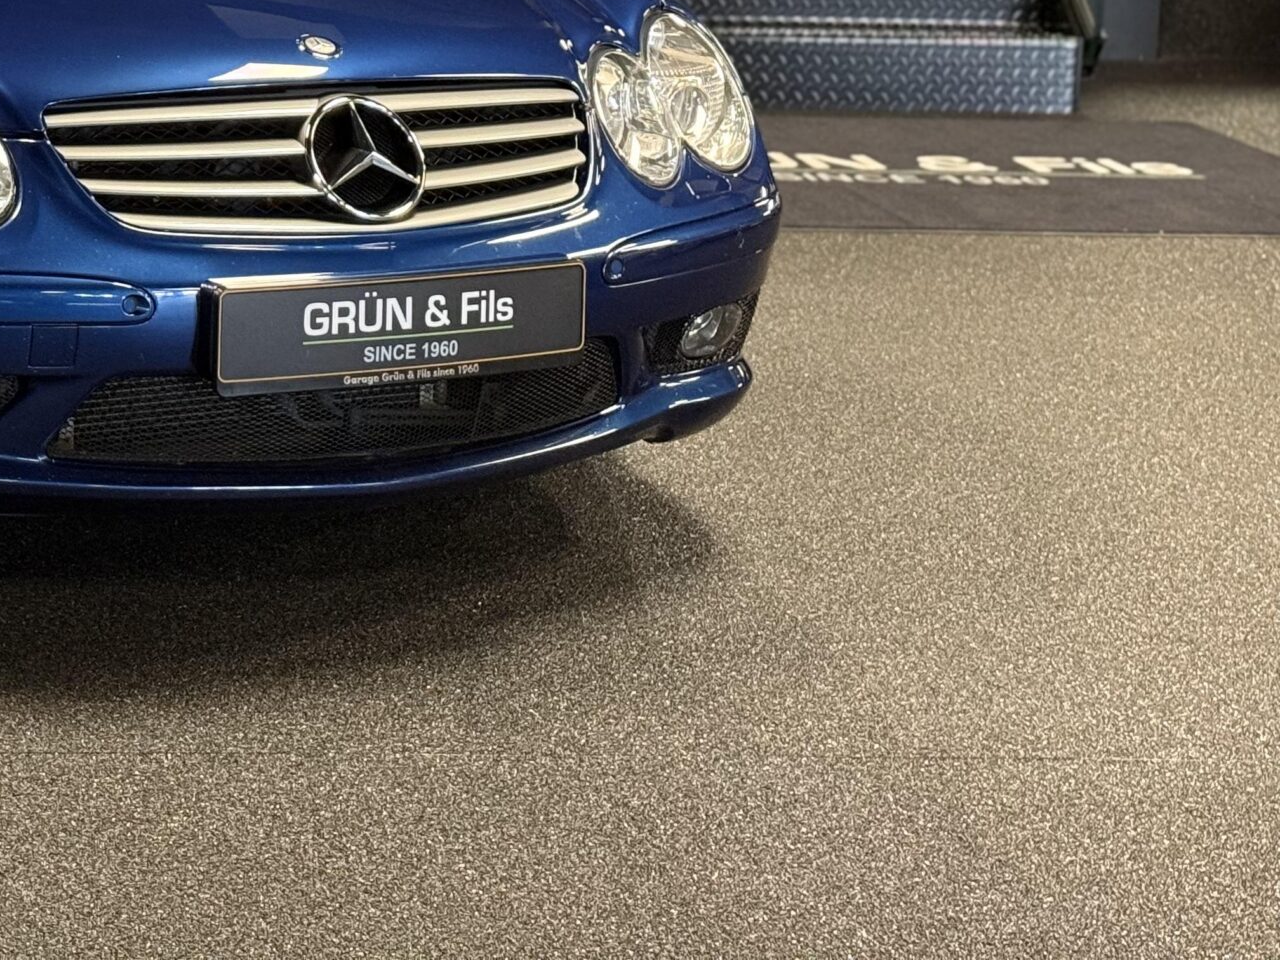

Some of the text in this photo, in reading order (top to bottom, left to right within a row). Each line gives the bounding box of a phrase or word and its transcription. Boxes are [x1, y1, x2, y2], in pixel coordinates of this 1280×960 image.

[916, 155, 1194, 176] & Fils
[303, 289, 514, 336] GRÜN & Fils
[363, 339, 458, 363] SINCE 1960
[343, 375, 379, 385] Garage
[407, 371, 415, 380] &
[433, 368, 455, 378] since
[457, 363, 479, 374] 1960
